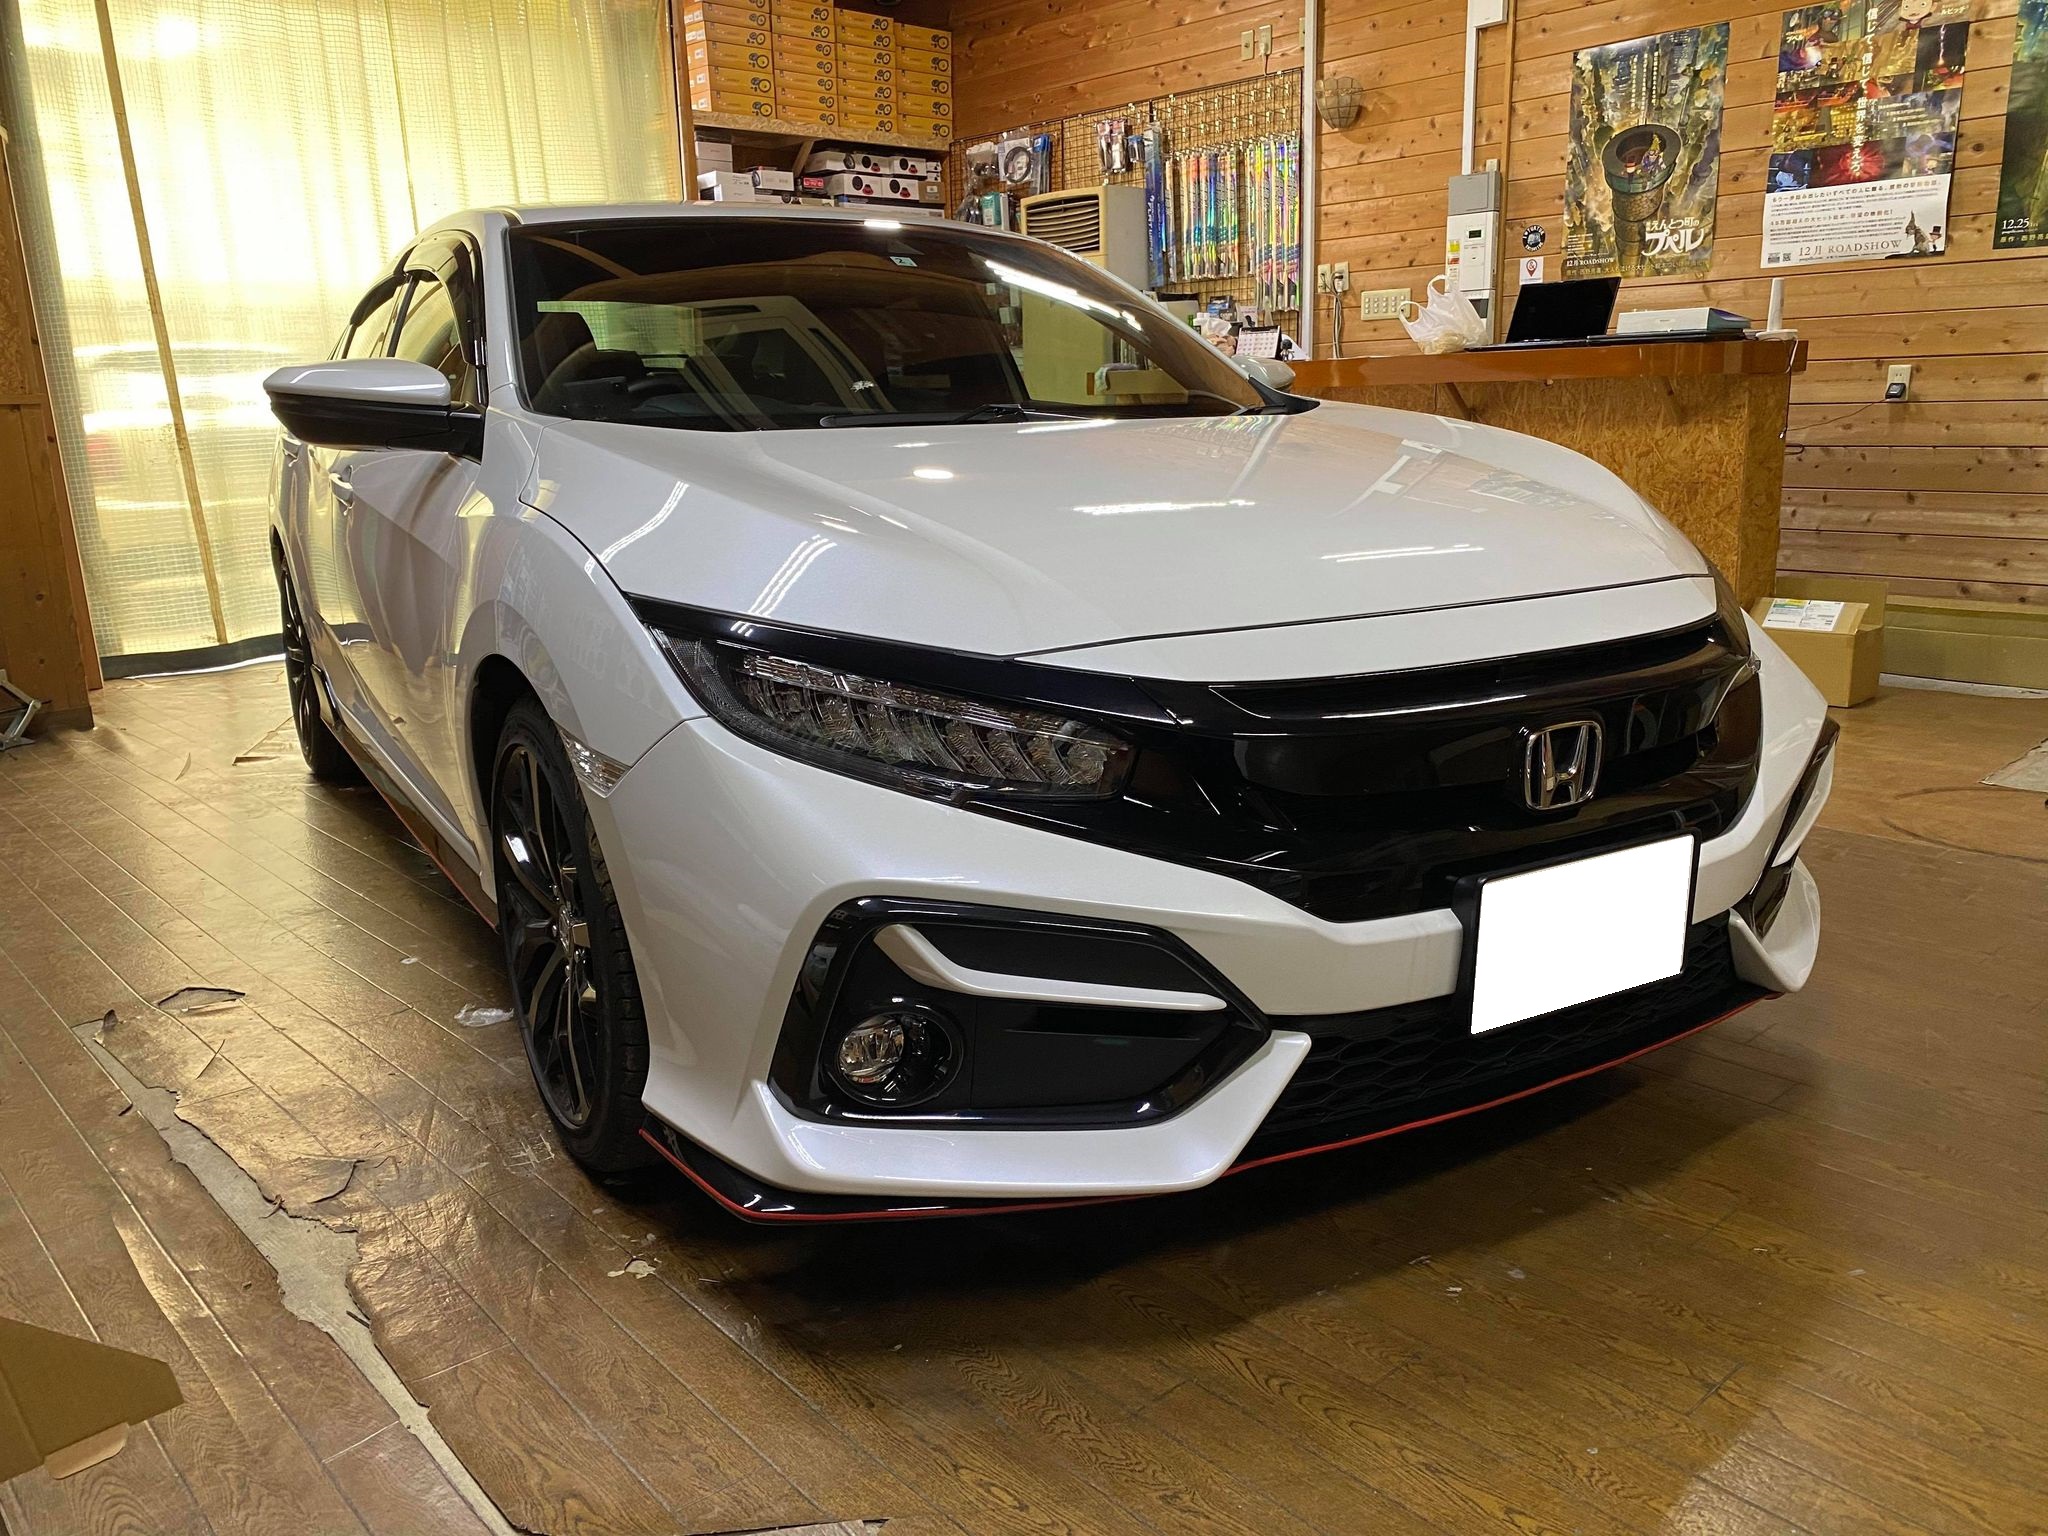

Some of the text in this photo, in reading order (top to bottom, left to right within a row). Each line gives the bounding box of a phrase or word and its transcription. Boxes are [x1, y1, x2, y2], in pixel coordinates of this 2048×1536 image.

[1652, 216, 1700, 231] えんとつ町の
[2002, 217, 2030, 230] 12.25
[1641, 227, 1705, 257] プペル
[1798, 239, 1902, 257] 12月 ROADSHOW
[1579, 256, 1615, 266] ROADSHOW
